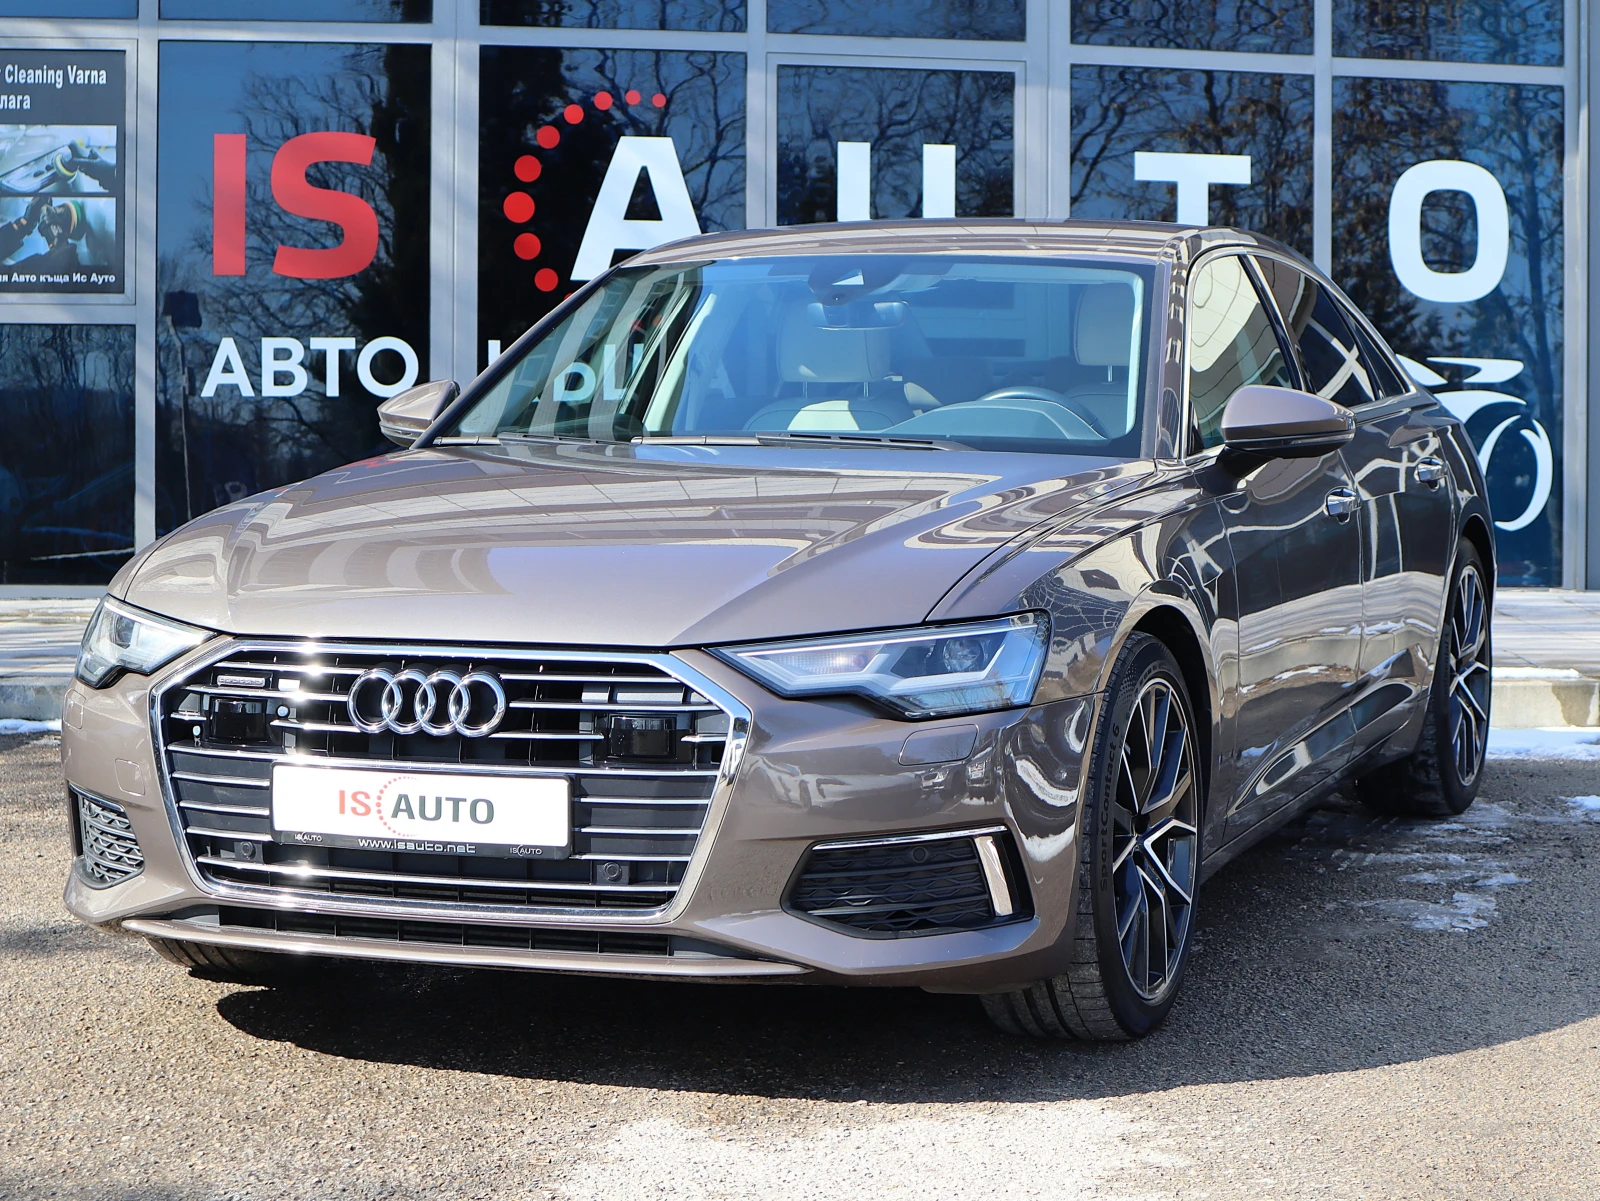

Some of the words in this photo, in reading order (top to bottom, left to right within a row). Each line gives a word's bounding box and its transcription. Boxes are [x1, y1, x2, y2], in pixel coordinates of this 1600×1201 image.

[5, 64, 63, 89] Cleaning
[67, 64, 107, 85] Varna
[213, 131, 378, 279] IS
[11, 272, 37, 283] Авто
[39, 274, 70, 285] къща
[72, 272, 88, 283] Ис
[90, 272, 116, 285] Ауто
[201, 336, 419, 398] АВТО
[338, 789, 372, 817] IS
[391, 793, 495, 825] AUTO
[358, 838, 476, 854] www.isauto.net
[519, 847, 543, 856] AUTO
